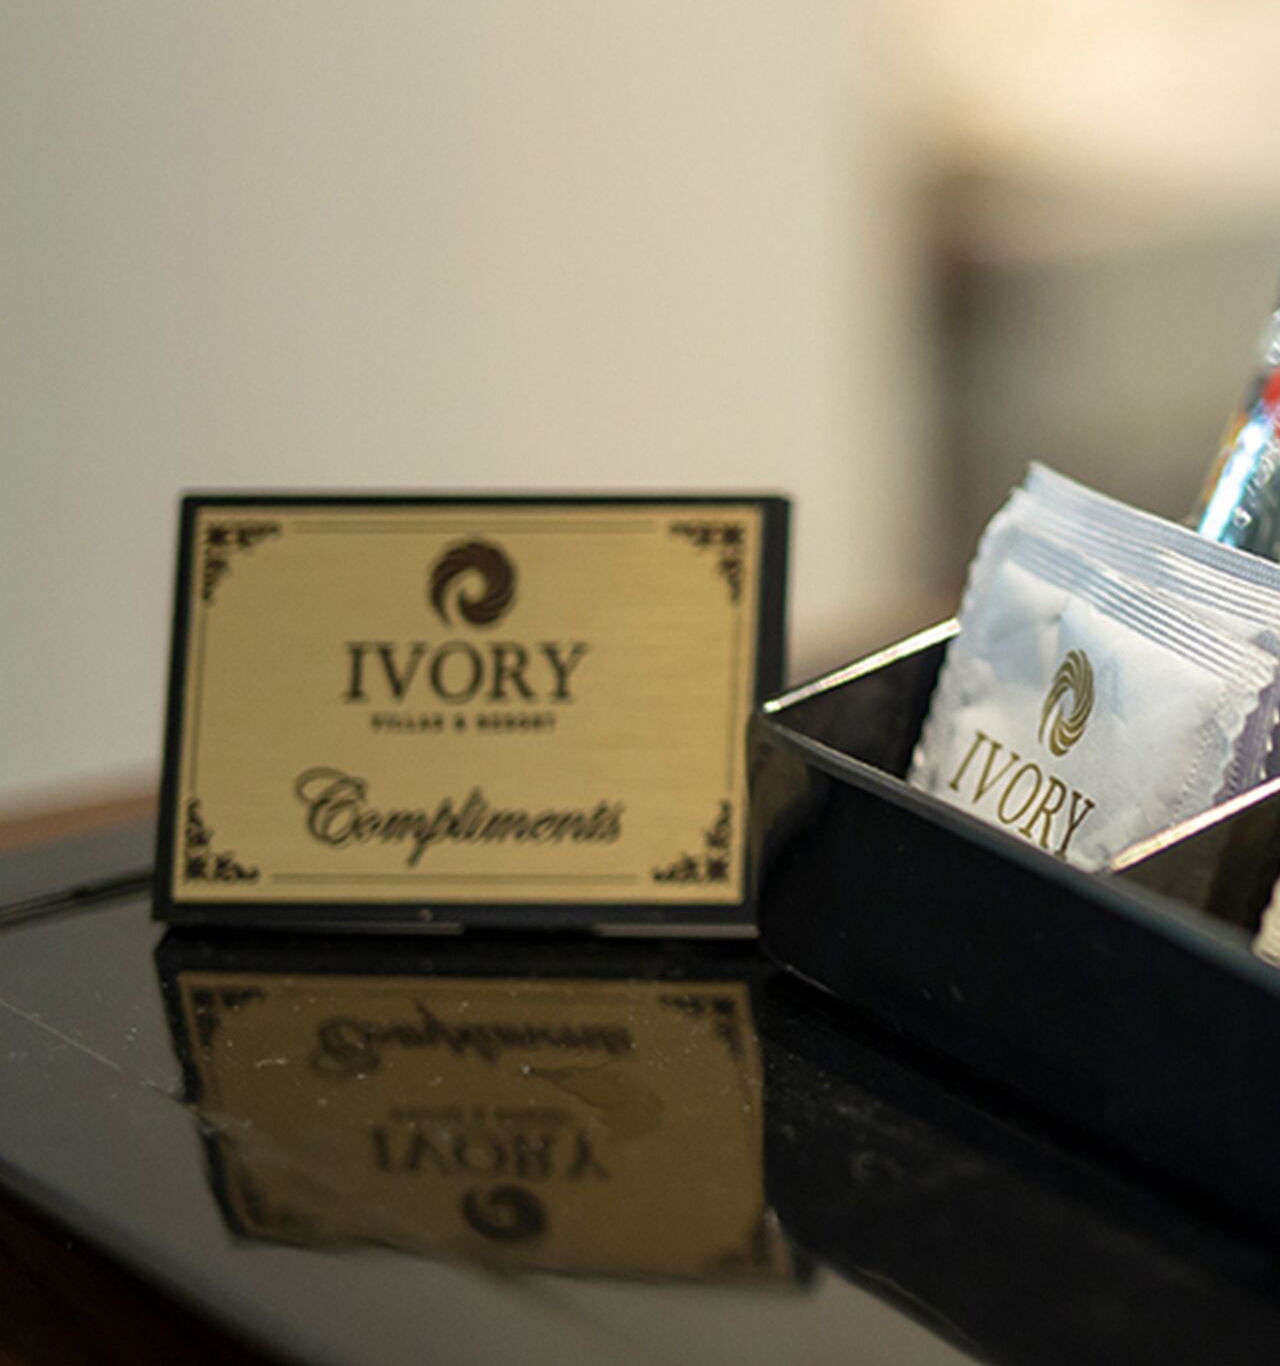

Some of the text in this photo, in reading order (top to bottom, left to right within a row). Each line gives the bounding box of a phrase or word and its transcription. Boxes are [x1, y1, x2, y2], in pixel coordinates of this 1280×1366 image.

[344, 639, 592, 705] IVORY
[295, 766, 625, 869] Compliments
[948, 730, 1096, 861] IVORY
